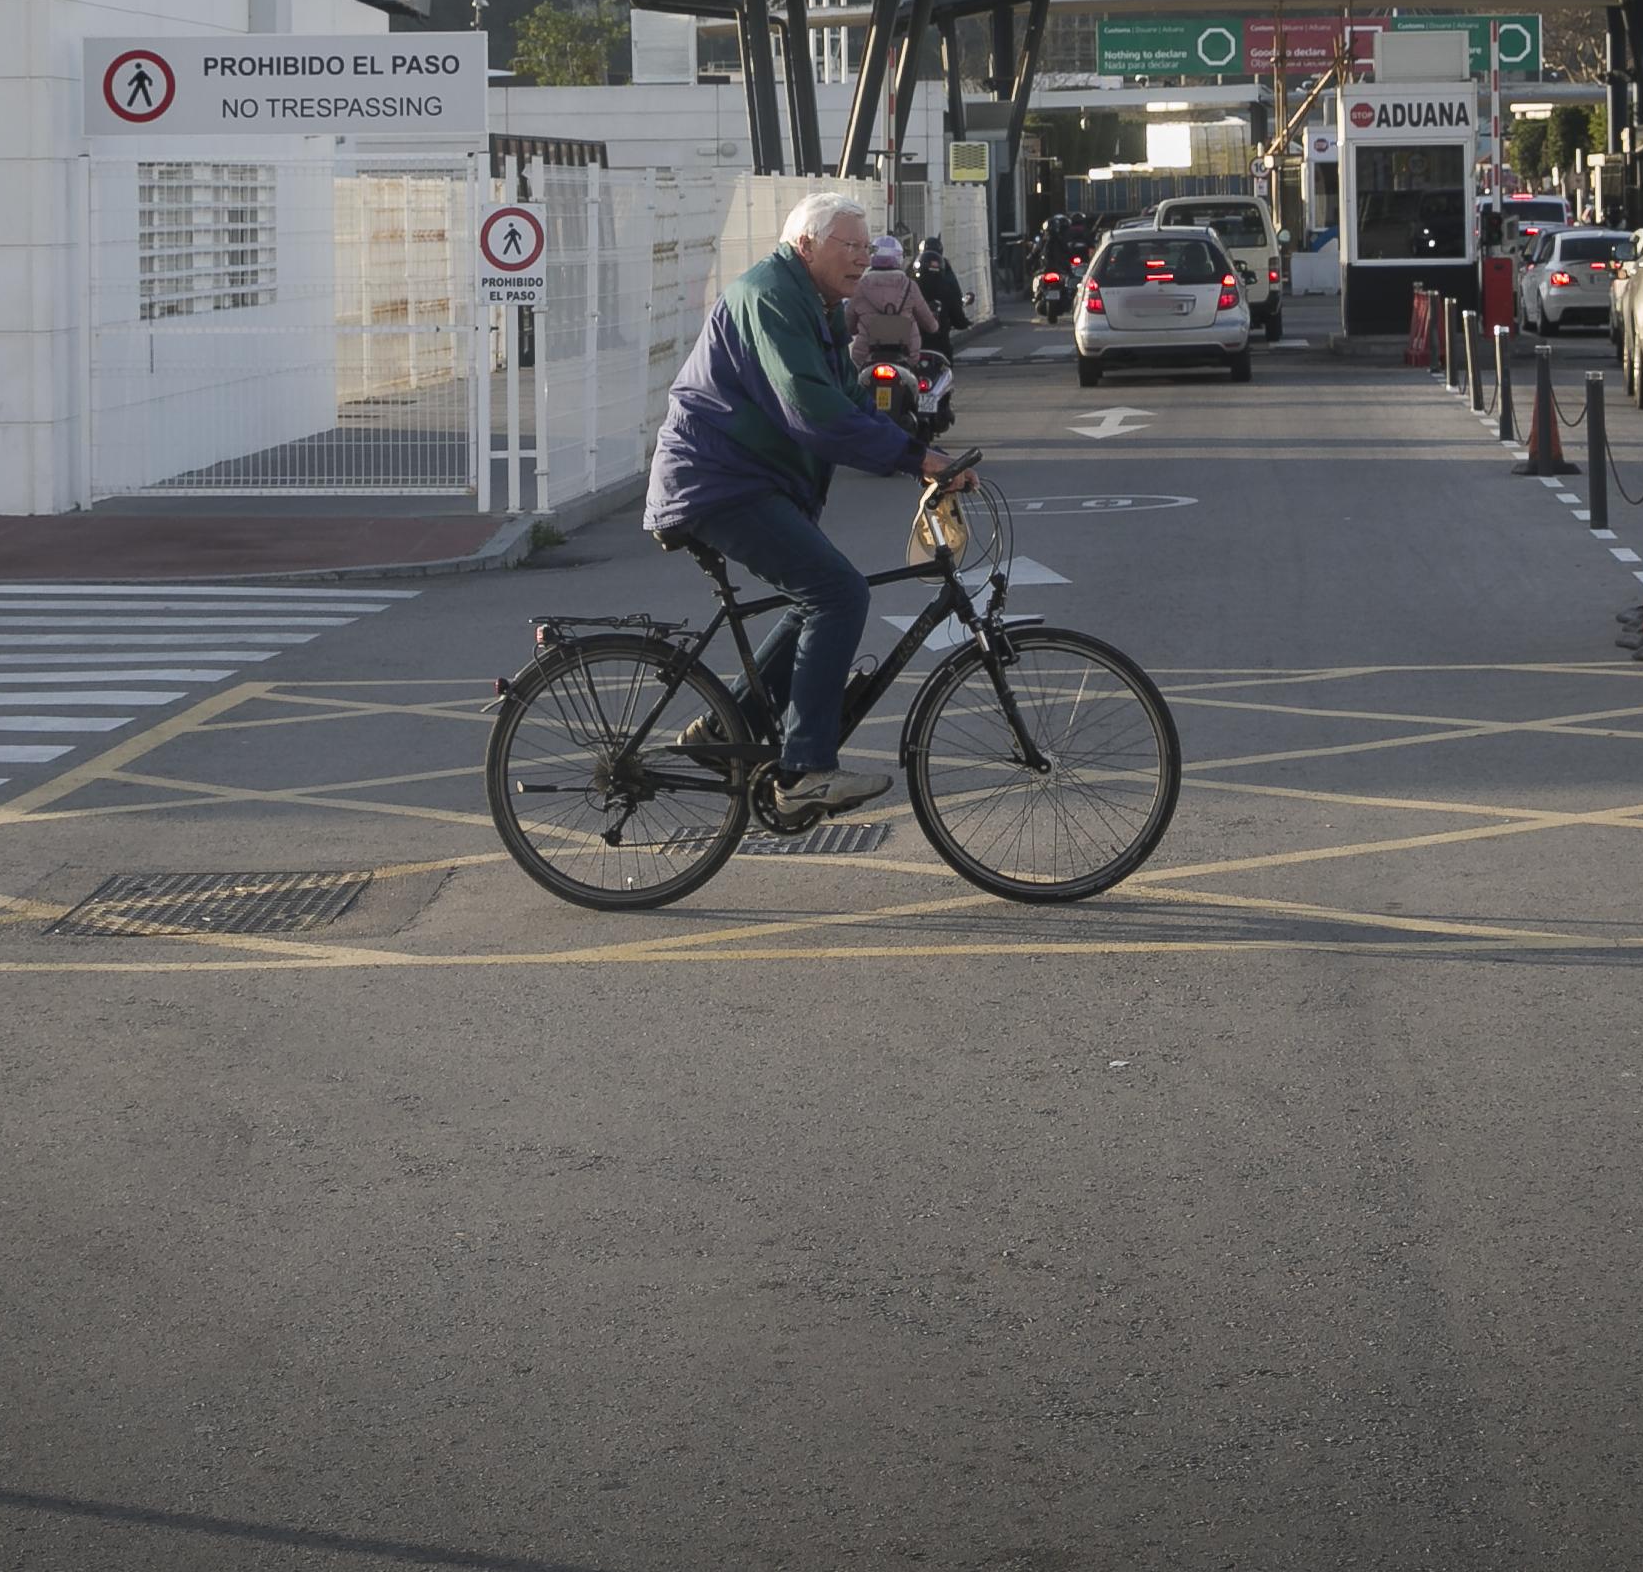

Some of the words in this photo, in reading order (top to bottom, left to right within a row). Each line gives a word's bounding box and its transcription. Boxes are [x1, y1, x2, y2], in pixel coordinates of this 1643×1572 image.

[1104, 50, 1141, 60] Nothing
[1143, 51, 1153, 59] to
[1155, 50, 1187, 59] declare
[1294, 47, 1327, 57] declare
[204, 56, 345, 77] PROHIBIDO
[353, 55, 384, 75] EL
[392, 55, 460, 75] PASO
[1104, 61, 1126, 69] Nada
[1127, 61, 1146, 70] para
[222, 98, 259, 118] NO
[266, 96, 443, 118] TRESPASSING
[1352, 111, 1374, 119] STOP
[1376, 102, 1470, 128] ADUANA
[481, 277, 543, 287] PROHIBIDO
[489, 291, 504, 301] EL
[507, 291, 536, 301] PASO
